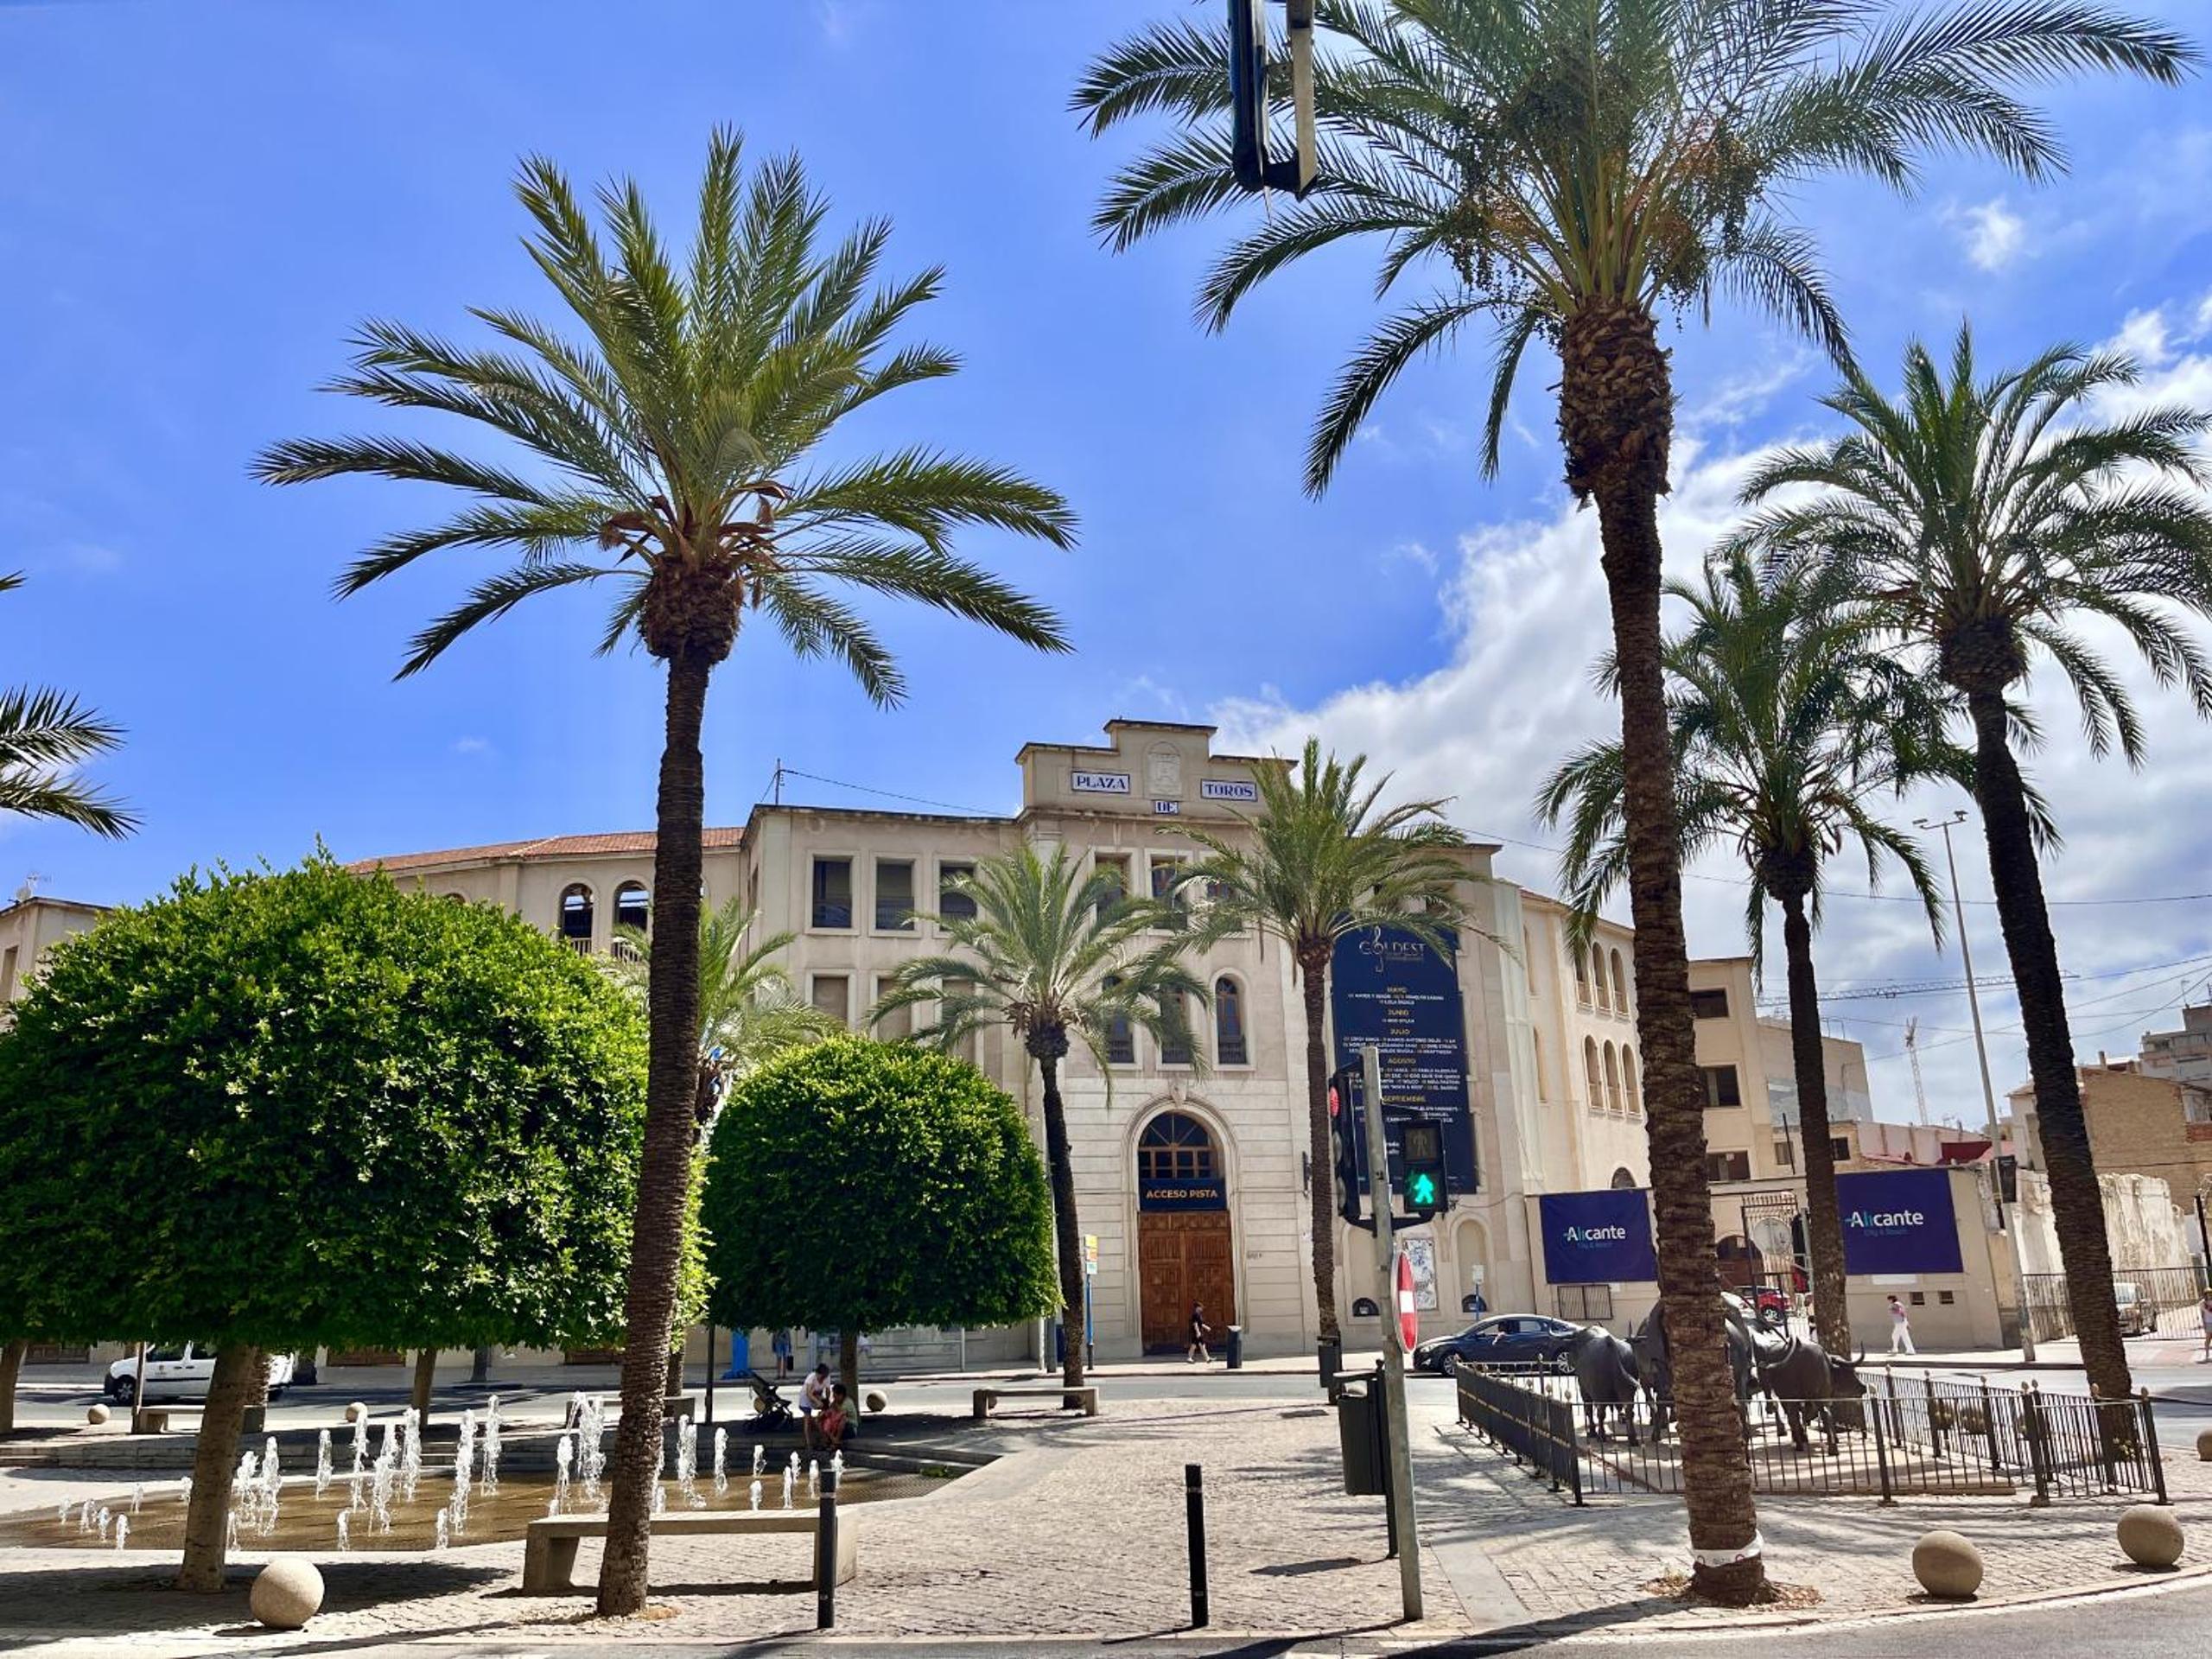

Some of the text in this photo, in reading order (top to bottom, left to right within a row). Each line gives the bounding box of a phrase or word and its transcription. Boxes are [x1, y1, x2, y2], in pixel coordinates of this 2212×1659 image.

[1077, 776, 1253, 813] PLAZA DE TOROS
[1147, 1189, 1217, 1198] ACCESO PISTA
[1847, 1211, 1923, 1228] Alicante
[1565, 1225, 1626, 1242] Alicante
